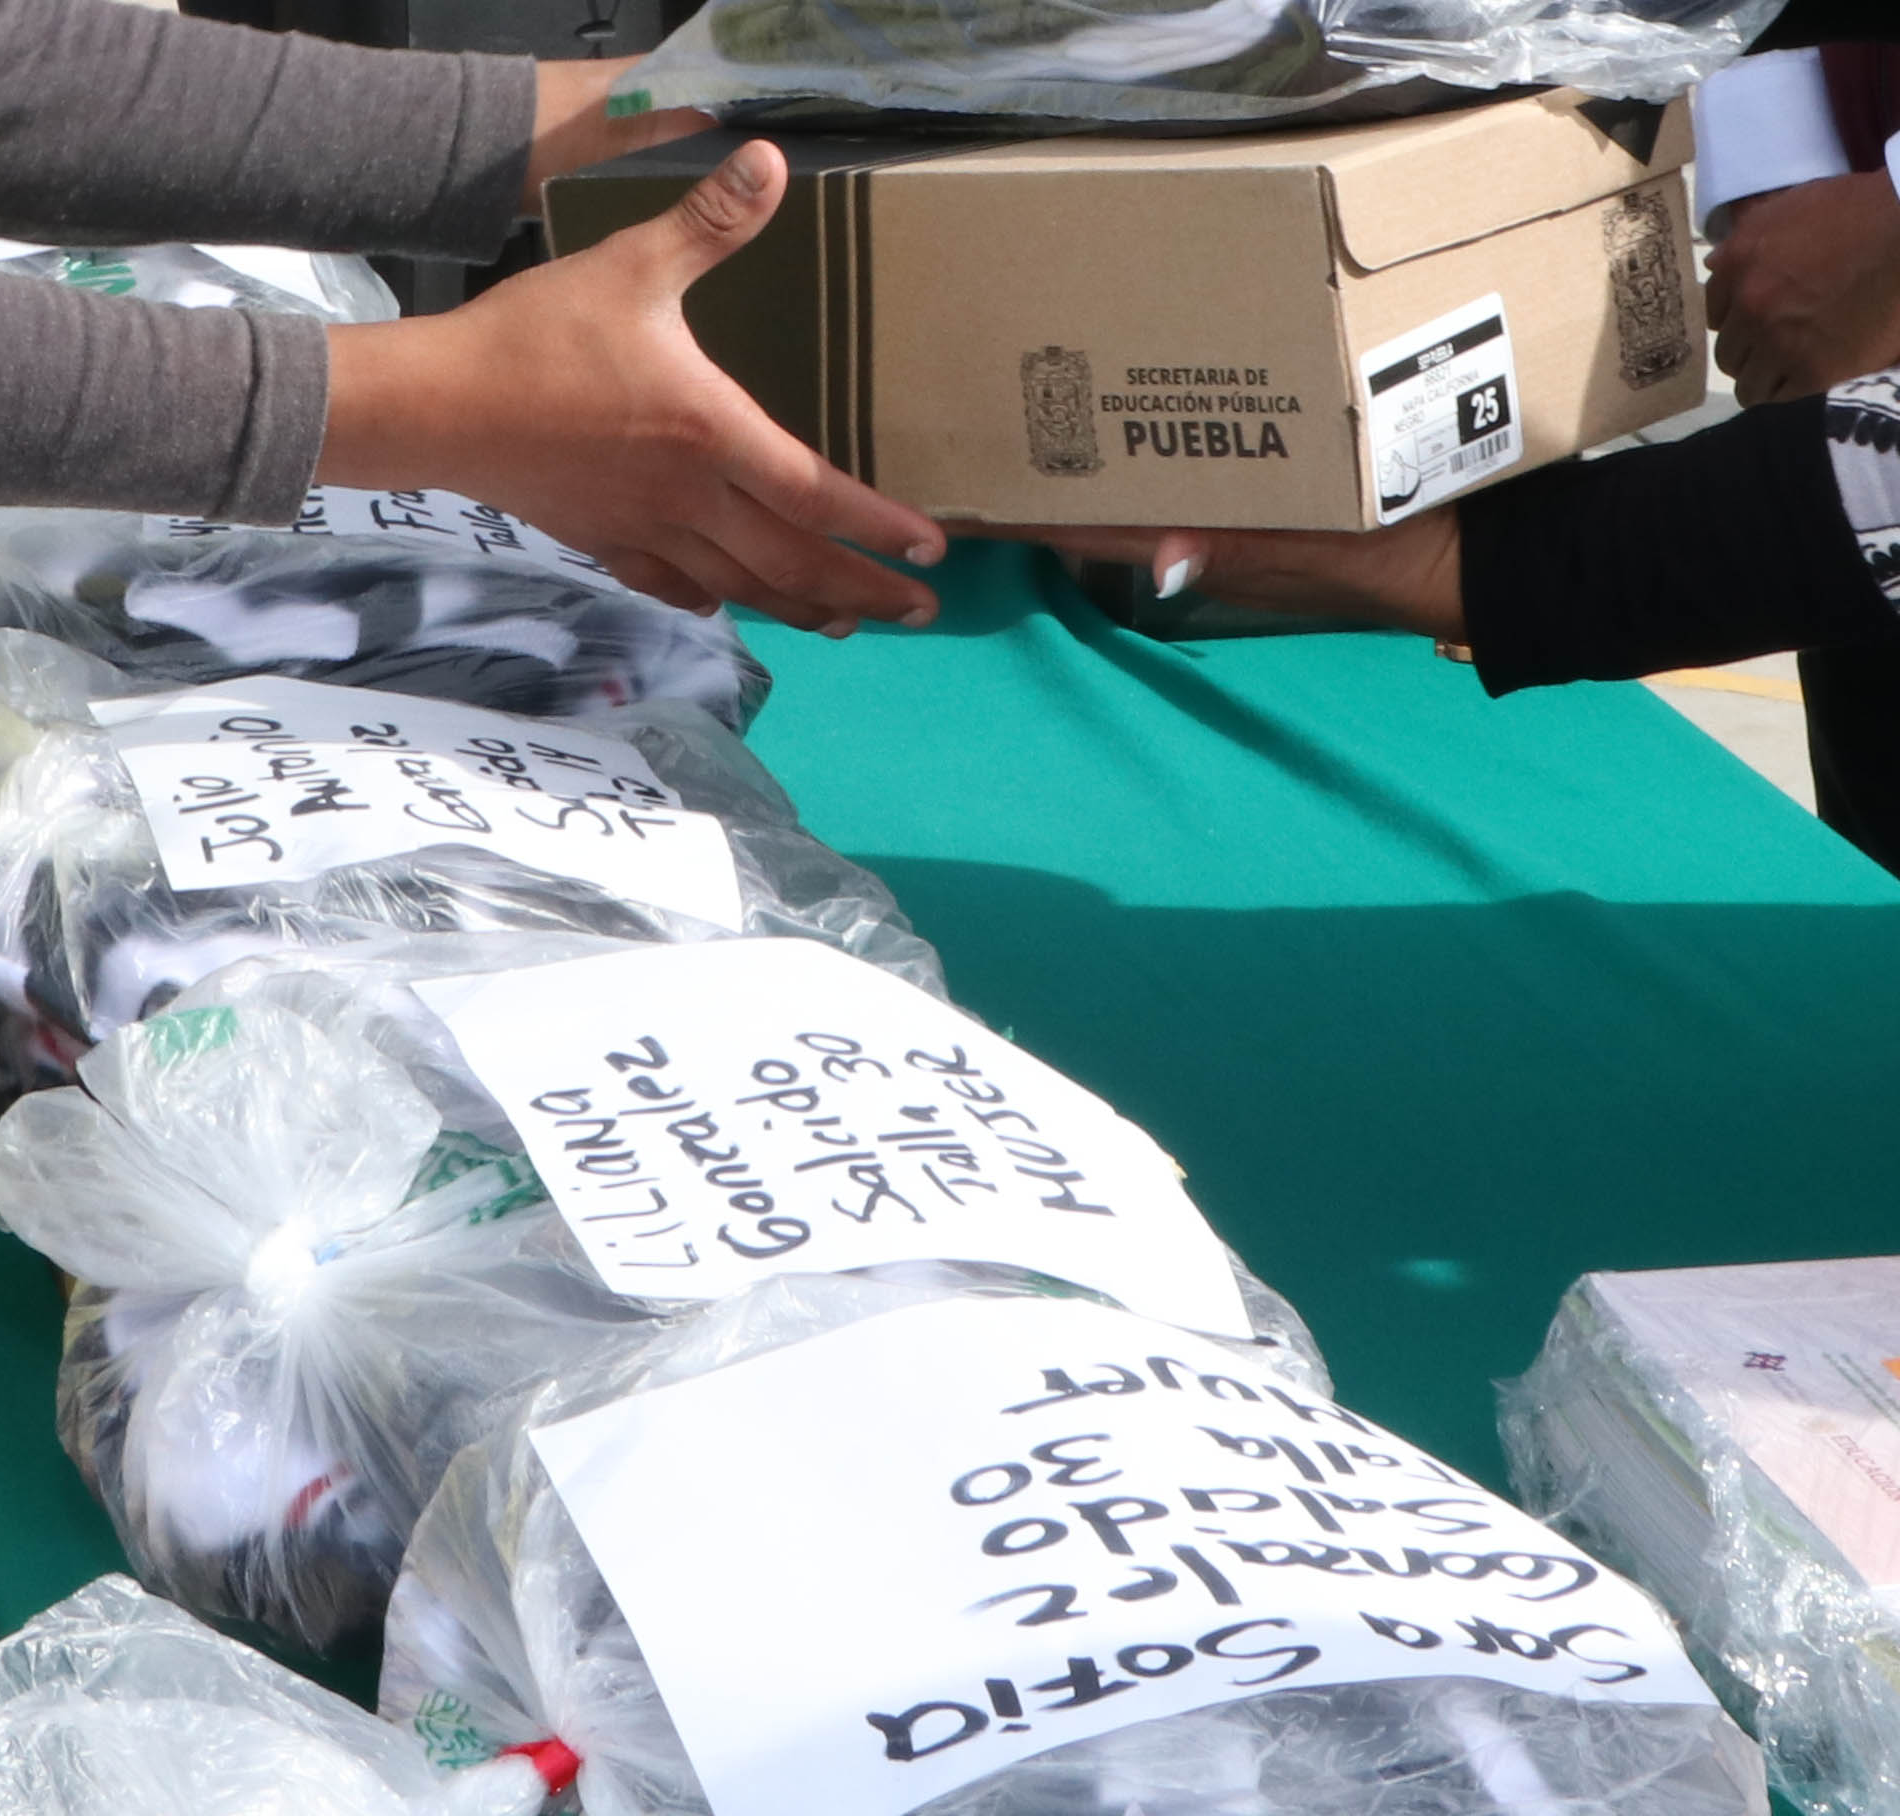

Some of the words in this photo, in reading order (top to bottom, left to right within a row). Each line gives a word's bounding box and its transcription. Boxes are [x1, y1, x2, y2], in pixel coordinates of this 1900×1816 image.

[1101, 390, 1213, 414] EDUCACIÓN
[1218, 390, 1302, 414] PÚBLICA
[1126, 367, 1241, 386] SECRETARIA
[1245, 368, 1269, 386] DE
[1470, 386, 1500, 431] 25
[1123, 419, 1290, 459] PUEBLA
[174, 774, 283, 864] Julio
[794, 1032, 894, 1084] 30
[950, 1432, 1123, 1507] 30
[981, 1484, 1492, 1559] Salcido
[1357, 1610, 1647, 1685] Sara
